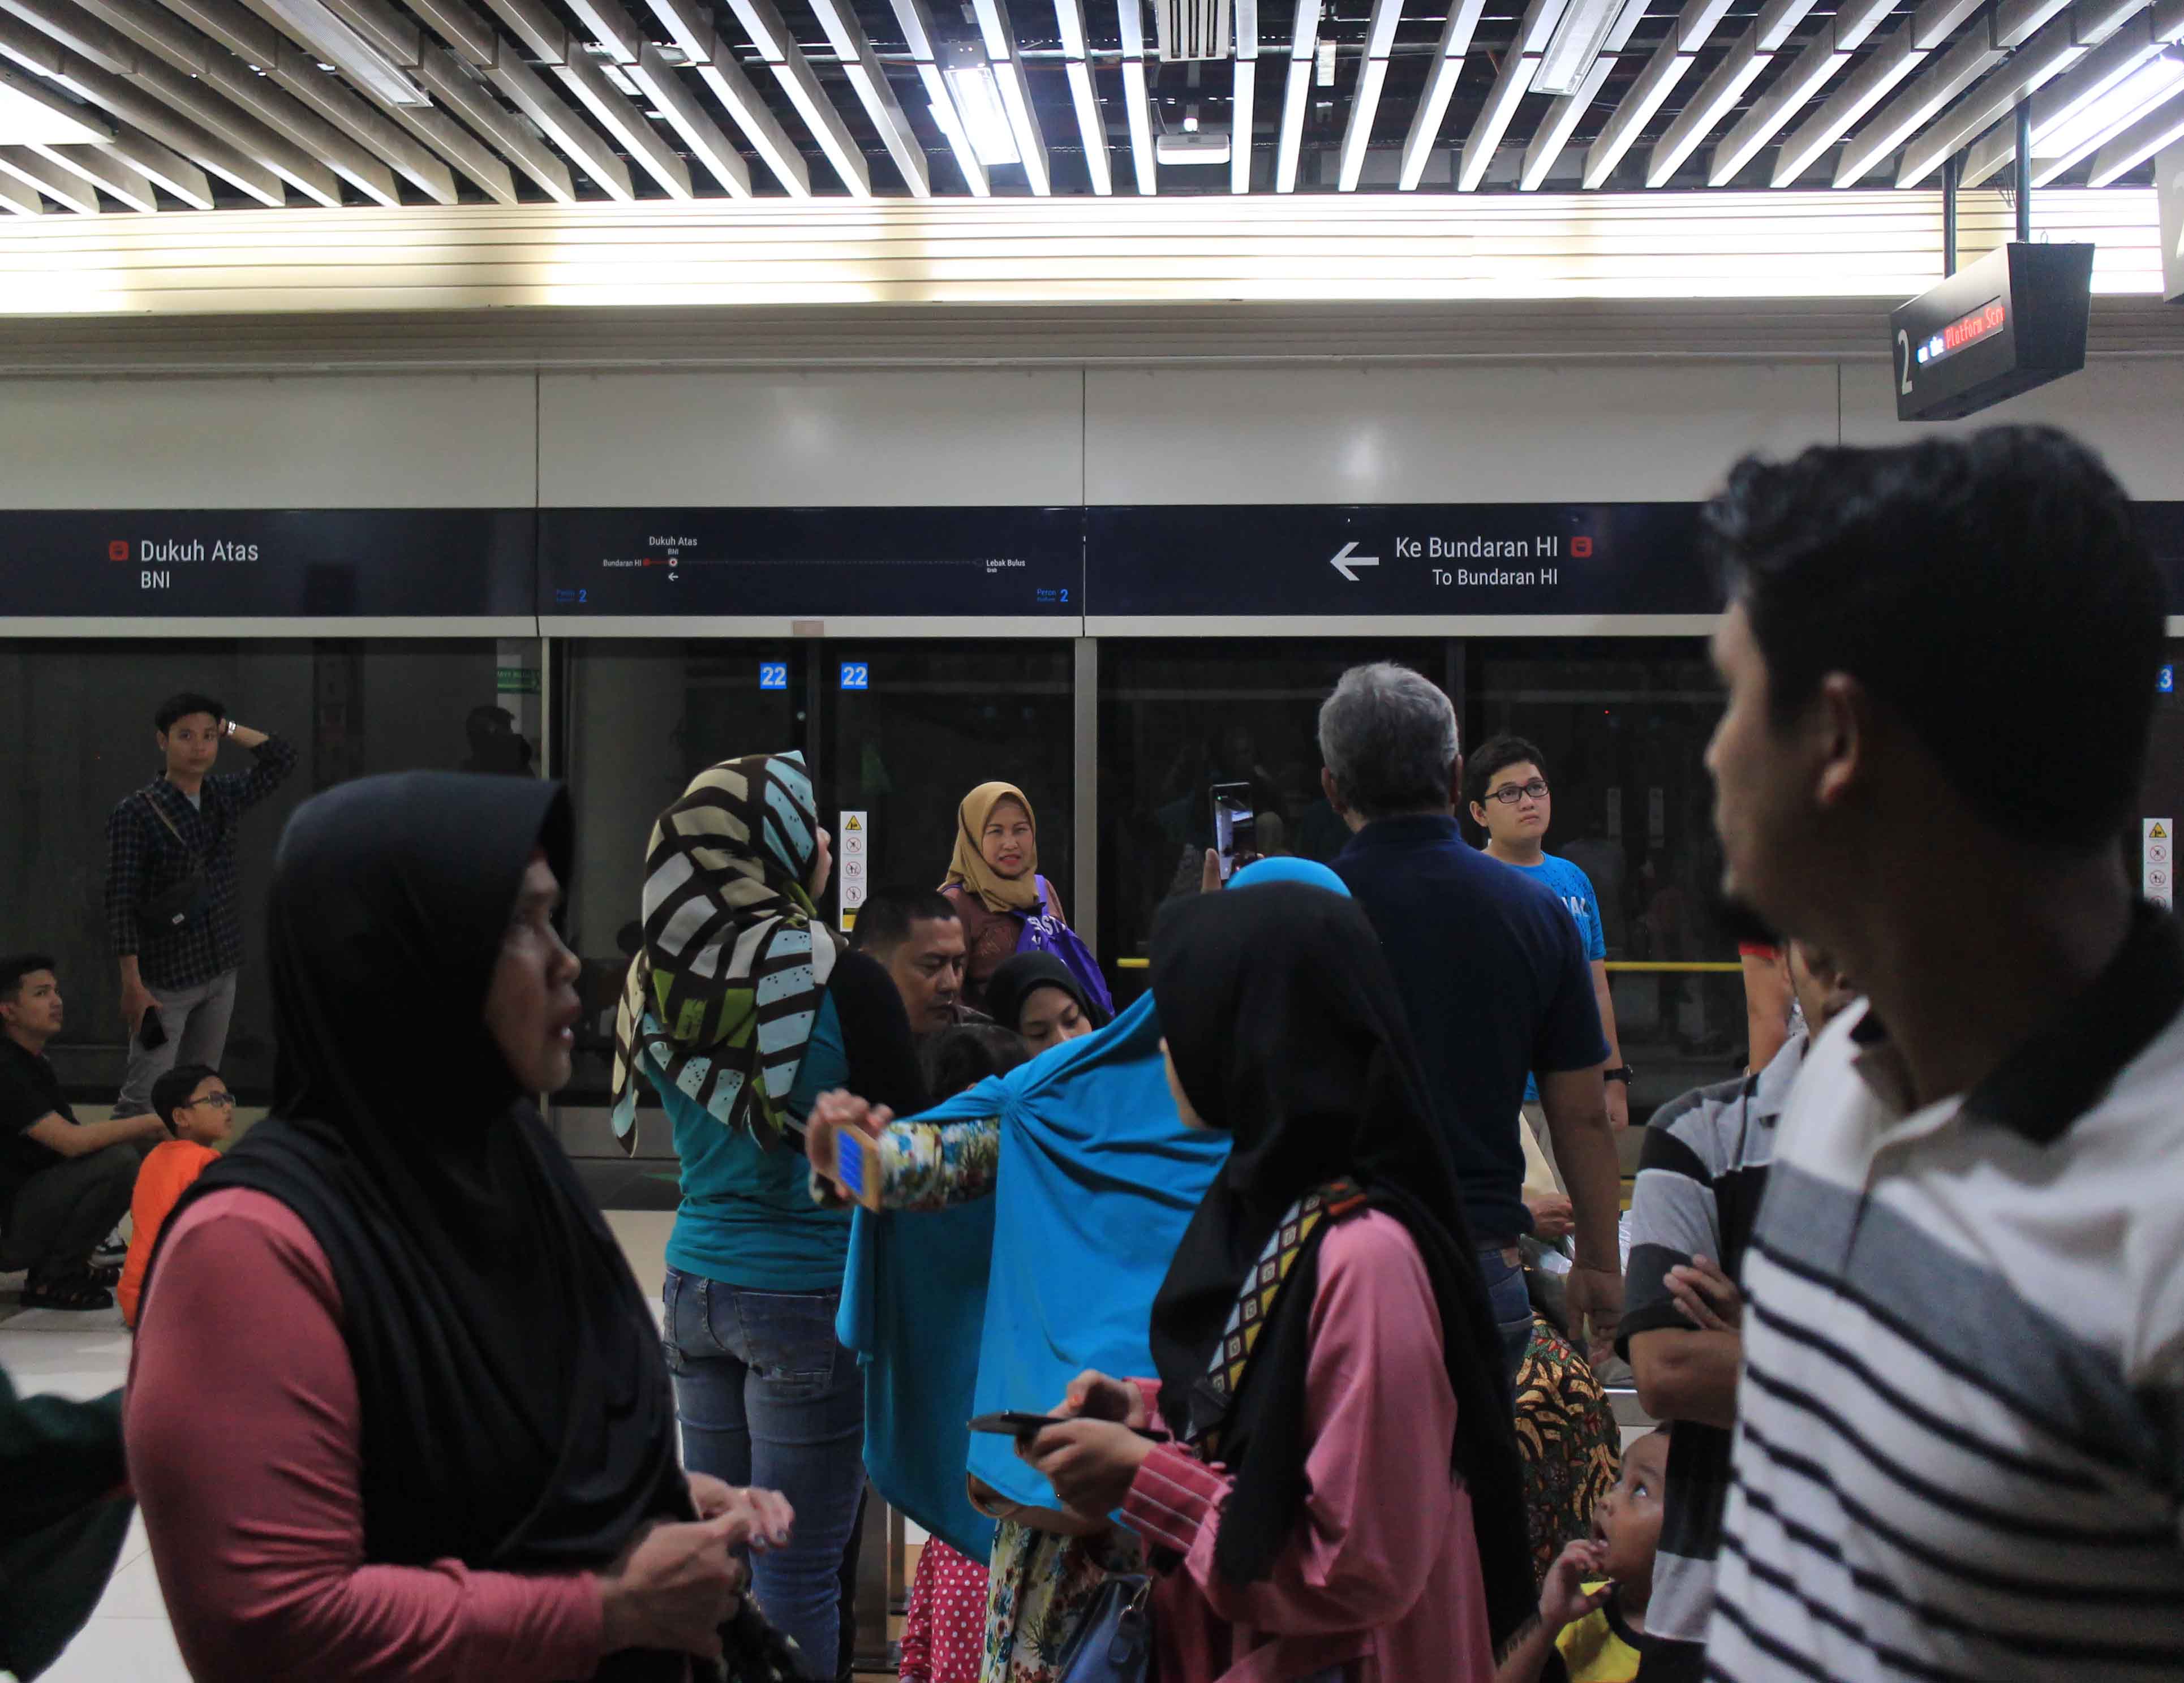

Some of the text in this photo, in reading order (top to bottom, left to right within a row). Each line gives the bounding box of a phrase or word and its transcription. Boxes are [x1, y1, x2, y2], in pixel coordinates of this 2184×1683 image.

[1945, 318, 1983, 349] Platform
[1898, 329, 1912, 395] 2
[141, 539, 259, 562] Dukuh Atas
[649, 536, 698, 546] Dukuh Atas
[1396, 536, 1558, 557] Ke Bundaran HI
[141, 571, 170, 589] BNI
[1432, 568, 1558, 585] To Bundaran HI
[579, 589, 587, 602] 2
[1060, 588, 1068, 602] 2
[762, 667, 786, 686] 22
[843, 666, 867, 686] 22
[2160, 669, 2172, 688] 3
